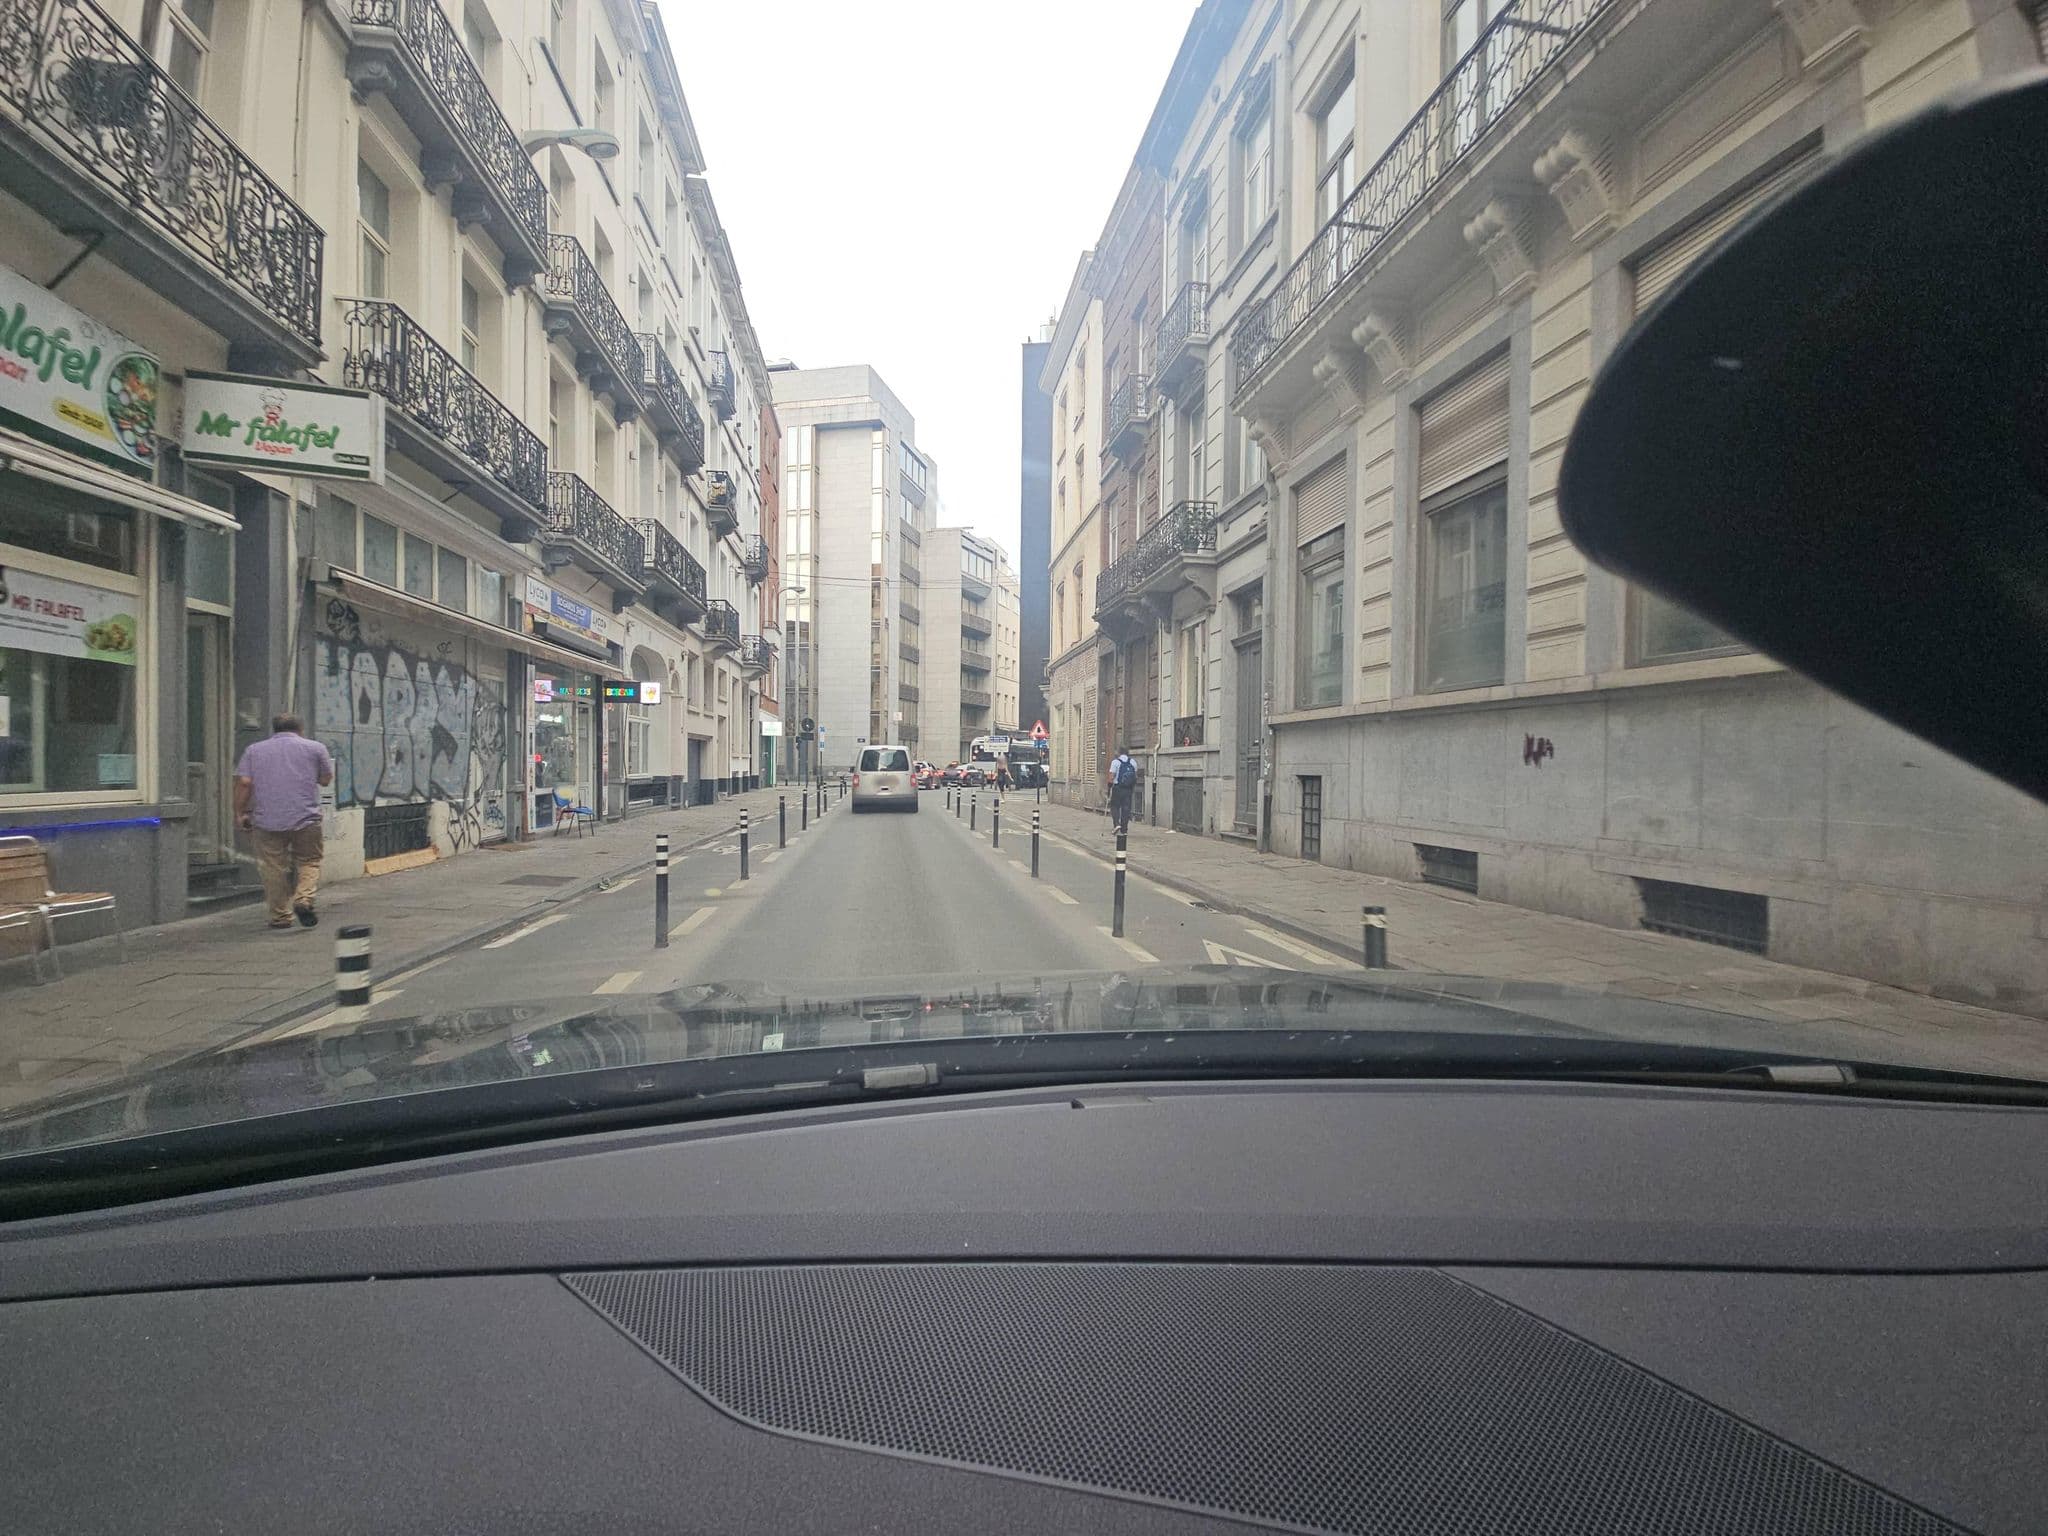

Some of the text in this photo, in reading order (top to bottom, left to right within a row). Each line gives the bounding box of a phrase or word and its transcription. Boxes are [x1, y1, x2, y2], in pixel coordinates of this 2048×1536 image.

[0, 302, 101, 391] lafel
[195, 410, 341, 452] Mr falafel
[34, 598, 87, 622] FALAFEL
